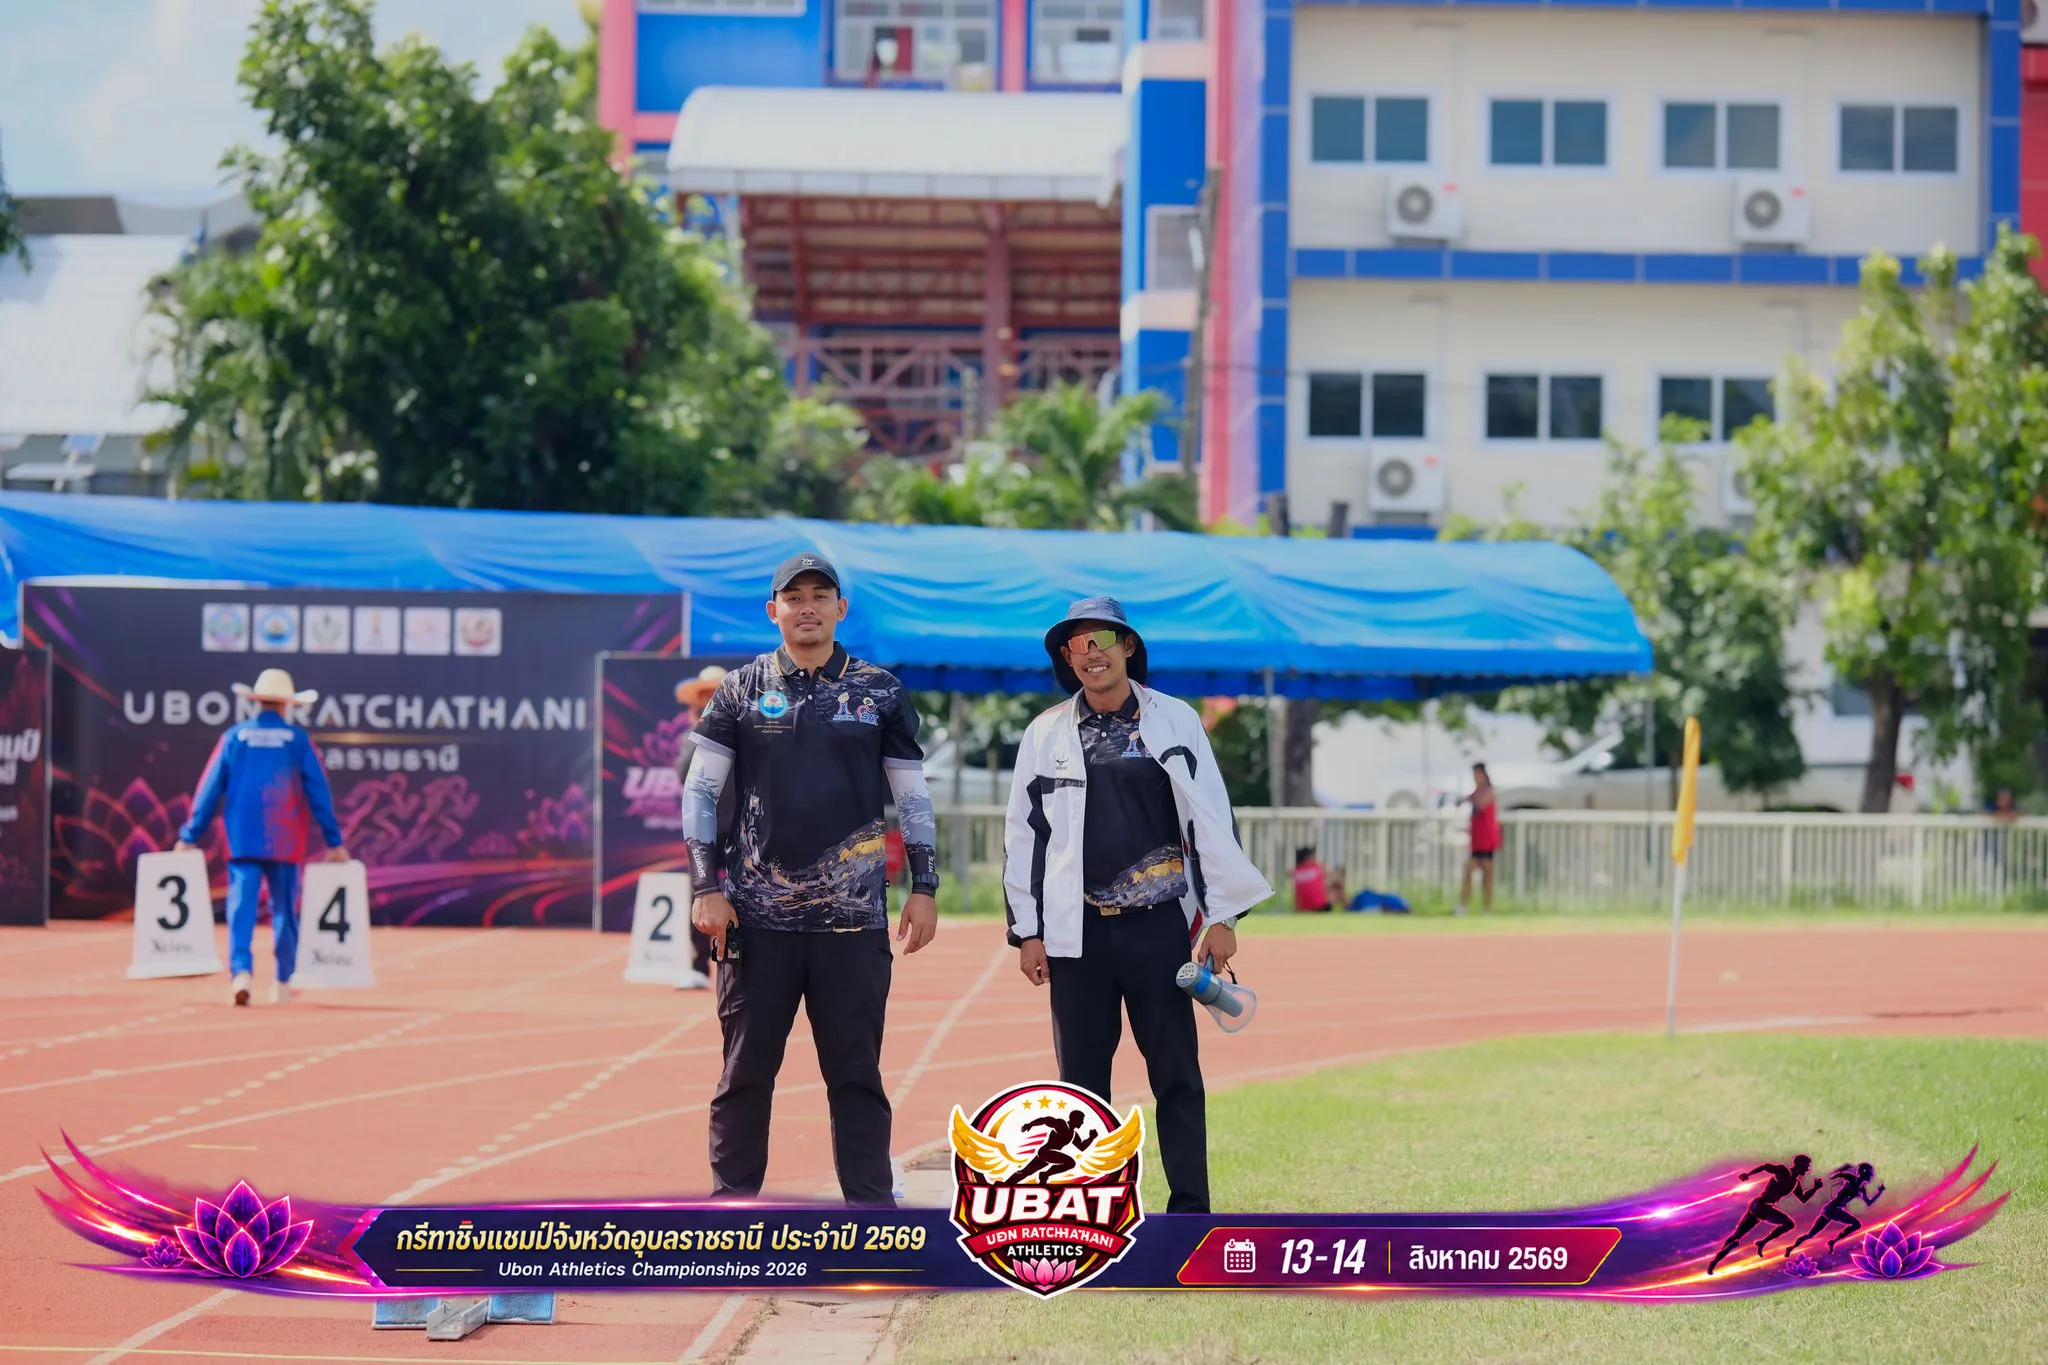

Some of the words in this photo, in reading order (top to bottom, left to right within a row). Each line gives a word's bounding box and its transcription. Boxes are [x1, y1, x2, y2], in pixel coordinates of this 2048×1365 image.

[284, 693, 587, 731] RATCHATHANI
[622, 766, 684, 798] UB
[691, 848, 707, 878] SPORTS
[156, 875, 190, 931] 3
[318, 886, 351, 943] 4
[650, 895, 673, 942] 2
